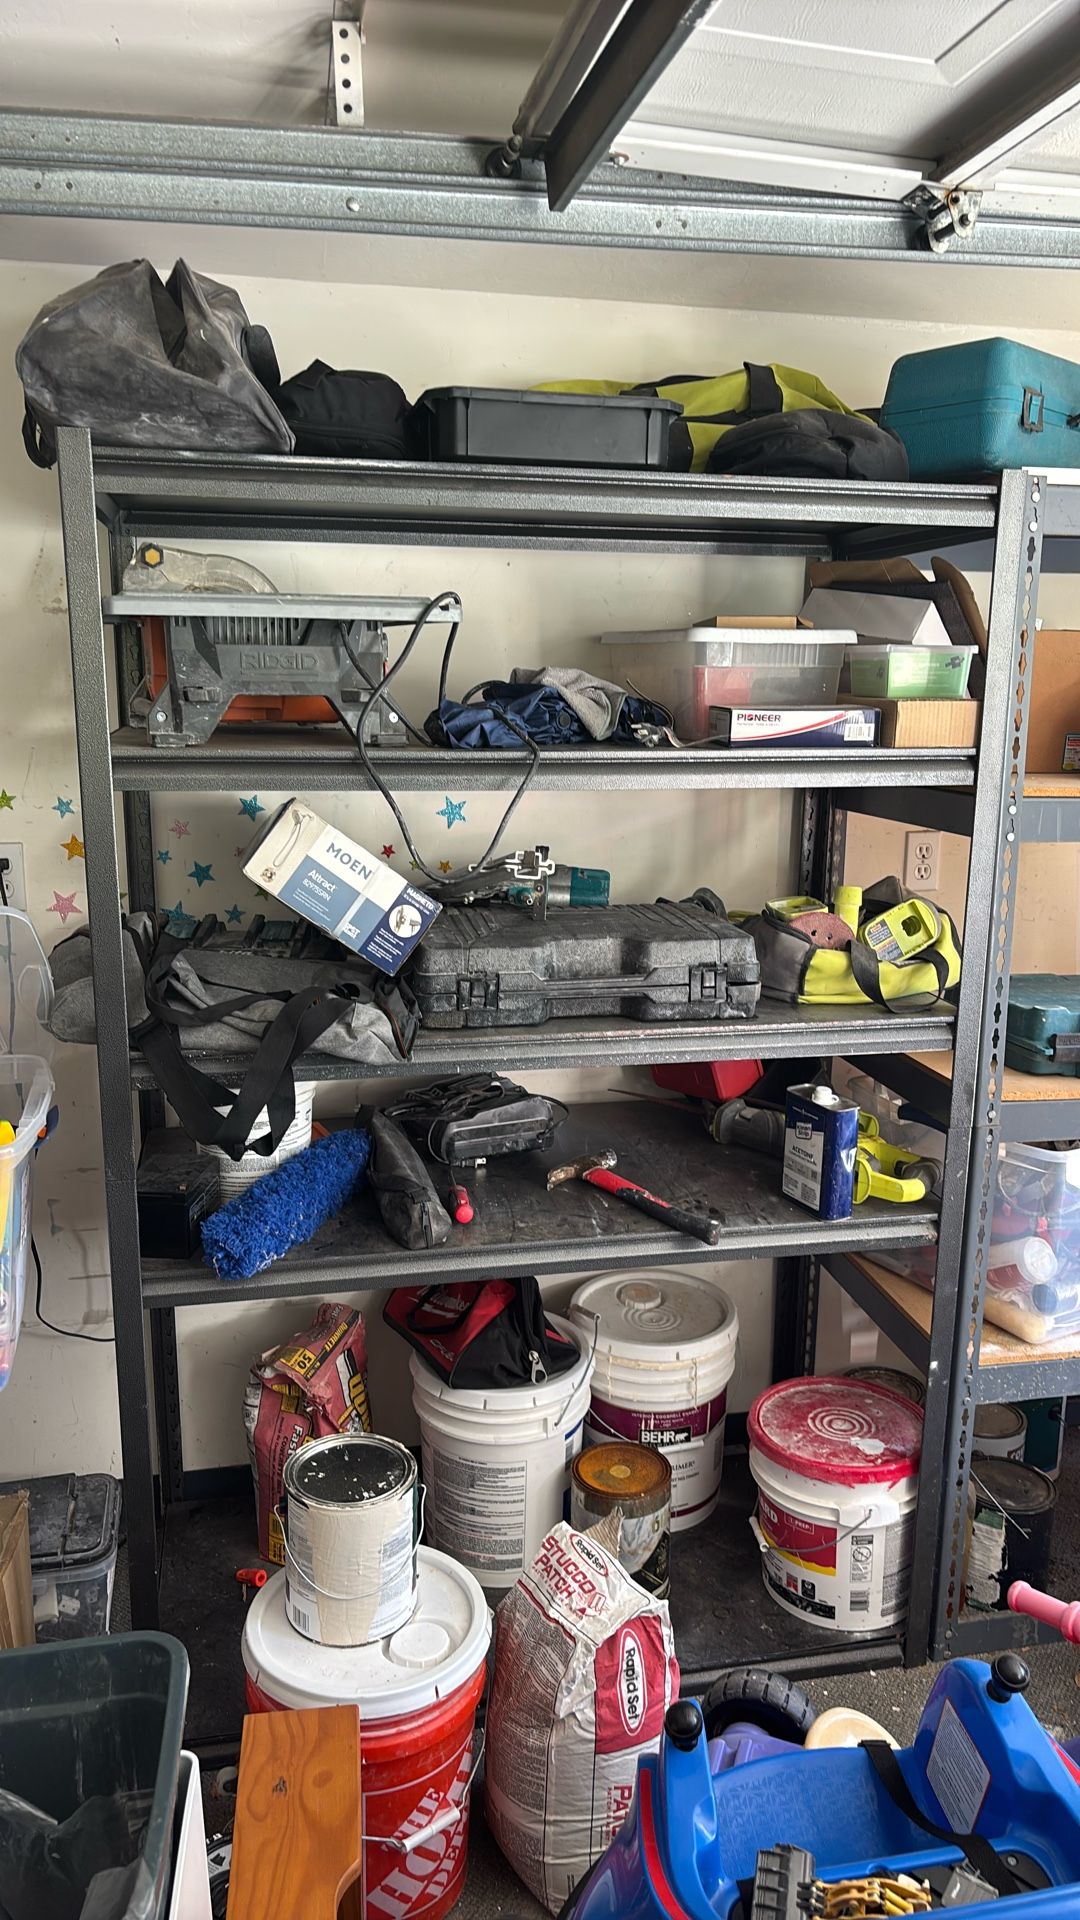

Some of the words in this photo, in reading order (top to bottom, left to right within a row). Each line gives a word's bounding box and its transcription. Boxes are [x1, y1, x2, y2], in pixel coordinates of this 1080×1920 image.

[240, 652, 319, 670] RIDGID
[736, 713, 781, 722] PIONEER
[326, 842, 373, 880] MOEN
[308, 869, 337, 893] Attract
[297, 1354, 312, 1370] 50
[641, 1430, 675, 1443] BEHR
[541, 1535, 597, 1594] STUCCO
[575, 1540, 593, 1559] Rapid
[591, 1556, 605, 1571] Set
[534, 1553, 576, 1600] PATCH
[624, 1646, 636, 1693] Rapid
[627, 1693, 640, 1721] Set
